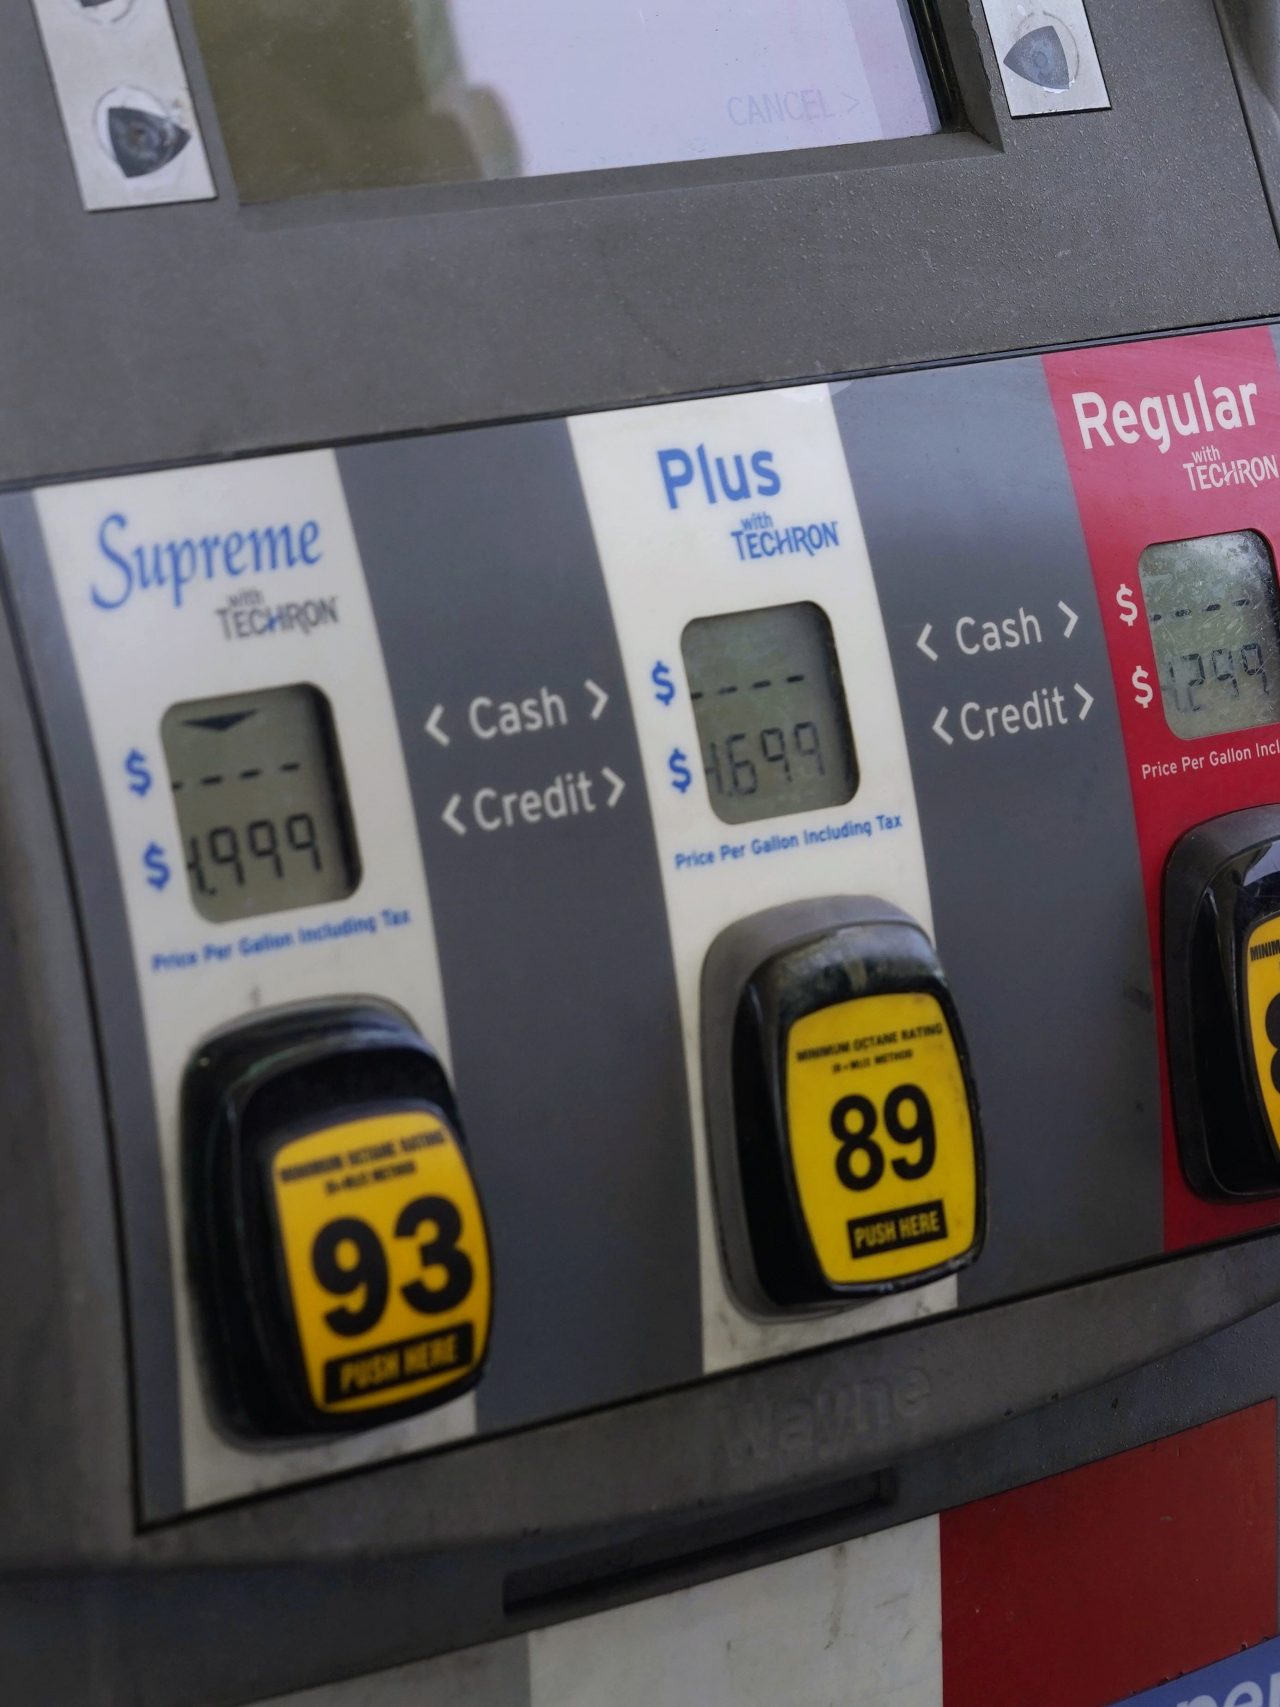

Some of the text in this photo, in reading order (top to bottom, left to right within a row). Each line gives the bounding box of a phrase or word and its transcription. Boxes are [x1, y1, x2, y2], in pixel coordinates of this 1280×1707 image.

[727, 89, 836, 126] CANCEL
[1071, 374, 1257, 454] Regular
[657, 443, 781, 509] Plus
[1182, 454, 1280, 491] TECHRON
[1191, 445, 1220, 464] with
[731, 521, 839, 561] TECHRON
[740, 511, 774, 531] with
[91, 513, 322, 610] Supreme
[216, 597, 338, 640] TECHRON
[1116, 583, 1138, 626] $
[956, 606, 1042, 655] Cash
[652, 661, 675, 706] $
[1131, 665, 1153, 708] $
[469, 686, 568, 739] Cash
[960, 686, 1068, 741] Credit
[125, 748, 152, 797] $
[668, 748, 692, 793] $
[1141, 762, 1177, 780] Price
[1181, 754, 1205, 772] Per
[1209, 746, 1252, 766] Gallon
[473, 771, 596, 831] Credit
[674, 813, 903, 870] Price Per Gallon Including Tax
[143, 842, 171, 891] $
[152, 909, 412, 972] Price Per Gallon Including Tax
[853, 1032, 898, 1052] OCTANE
[901, 1022, 943, 1040] RATING
[829, 1083, 937, 1192] 89
[854, 1210, 941, 1249] PUSH HERE
[311, 1193, 474, 1338] 93
